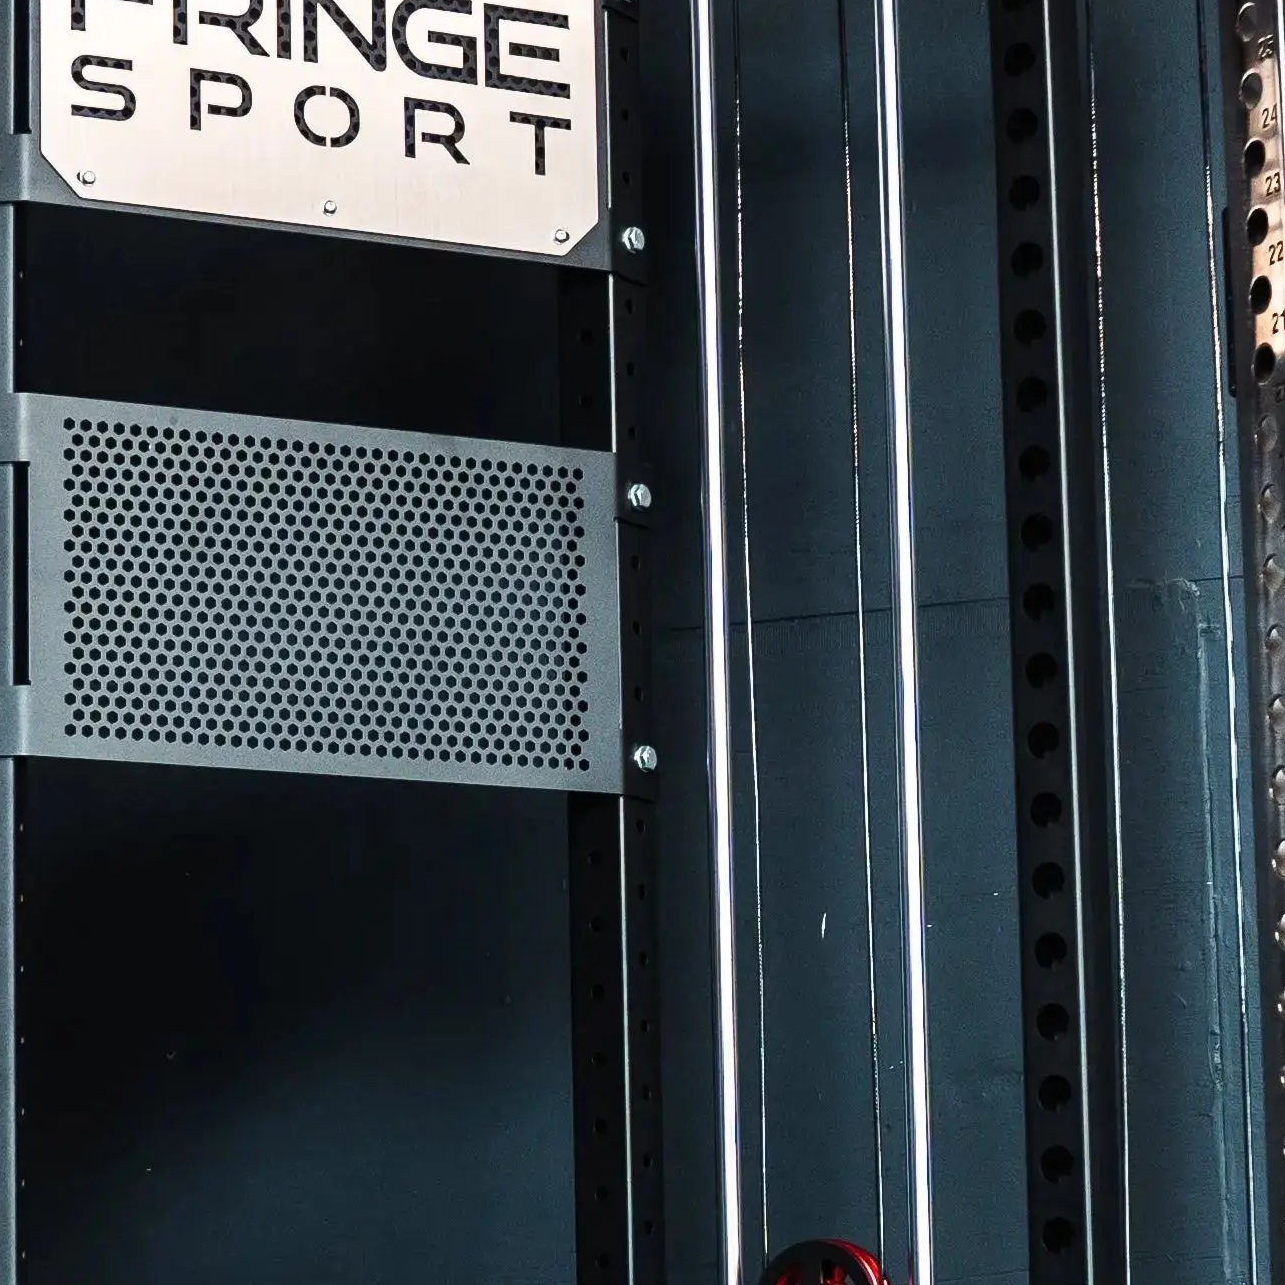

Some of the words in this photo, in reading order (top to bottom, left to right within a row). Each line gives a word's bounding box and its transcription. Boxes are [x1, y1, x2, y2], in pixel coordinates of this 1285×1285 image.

[70, 54, 572, 176] SPORT
[1261, 102, 1278, 129] 24
[1265, 171, 1281, 197] 23
[1268, 240, 1284, 266] 22
